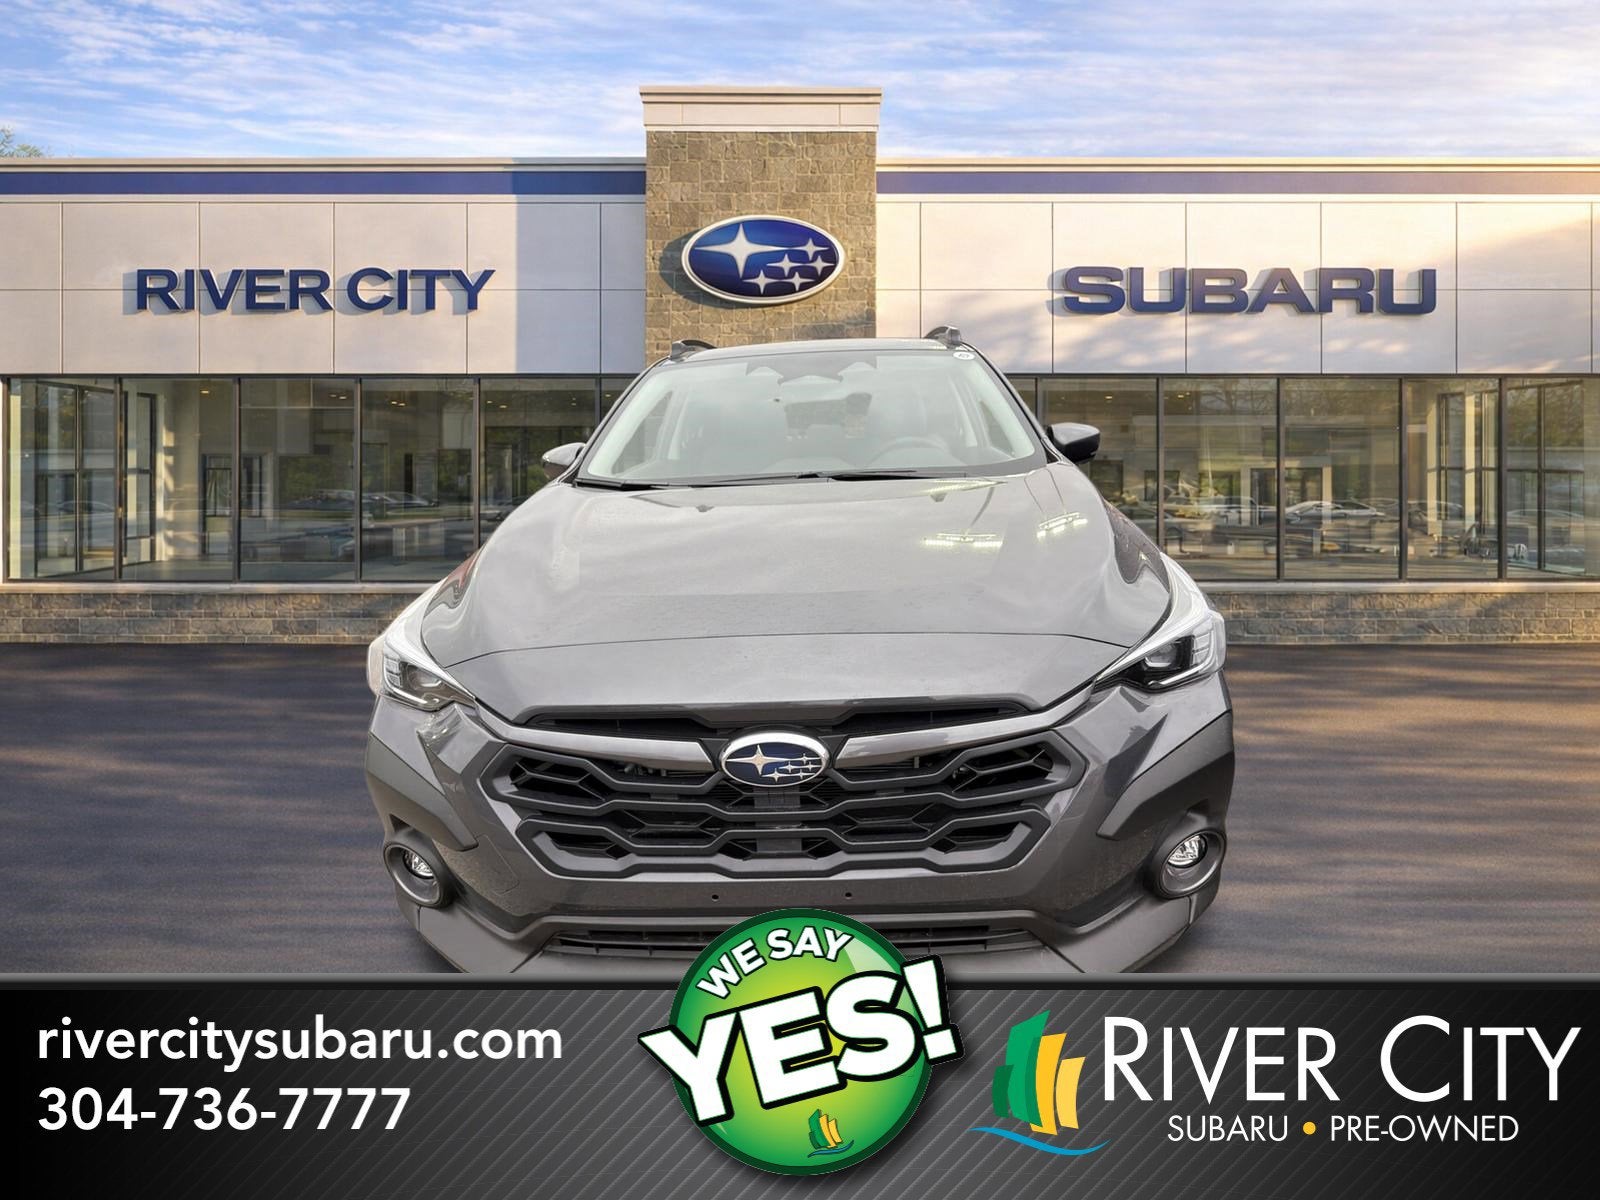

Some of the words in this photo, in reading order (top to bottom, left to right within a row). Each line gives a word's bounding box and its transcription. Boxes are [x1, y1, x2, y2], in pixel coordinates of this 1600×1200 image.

[136, 268, 334, 311] RIVER
[346, 267, 496, 311] CITY
[1063, 266, 1437, 315] SUBARU
